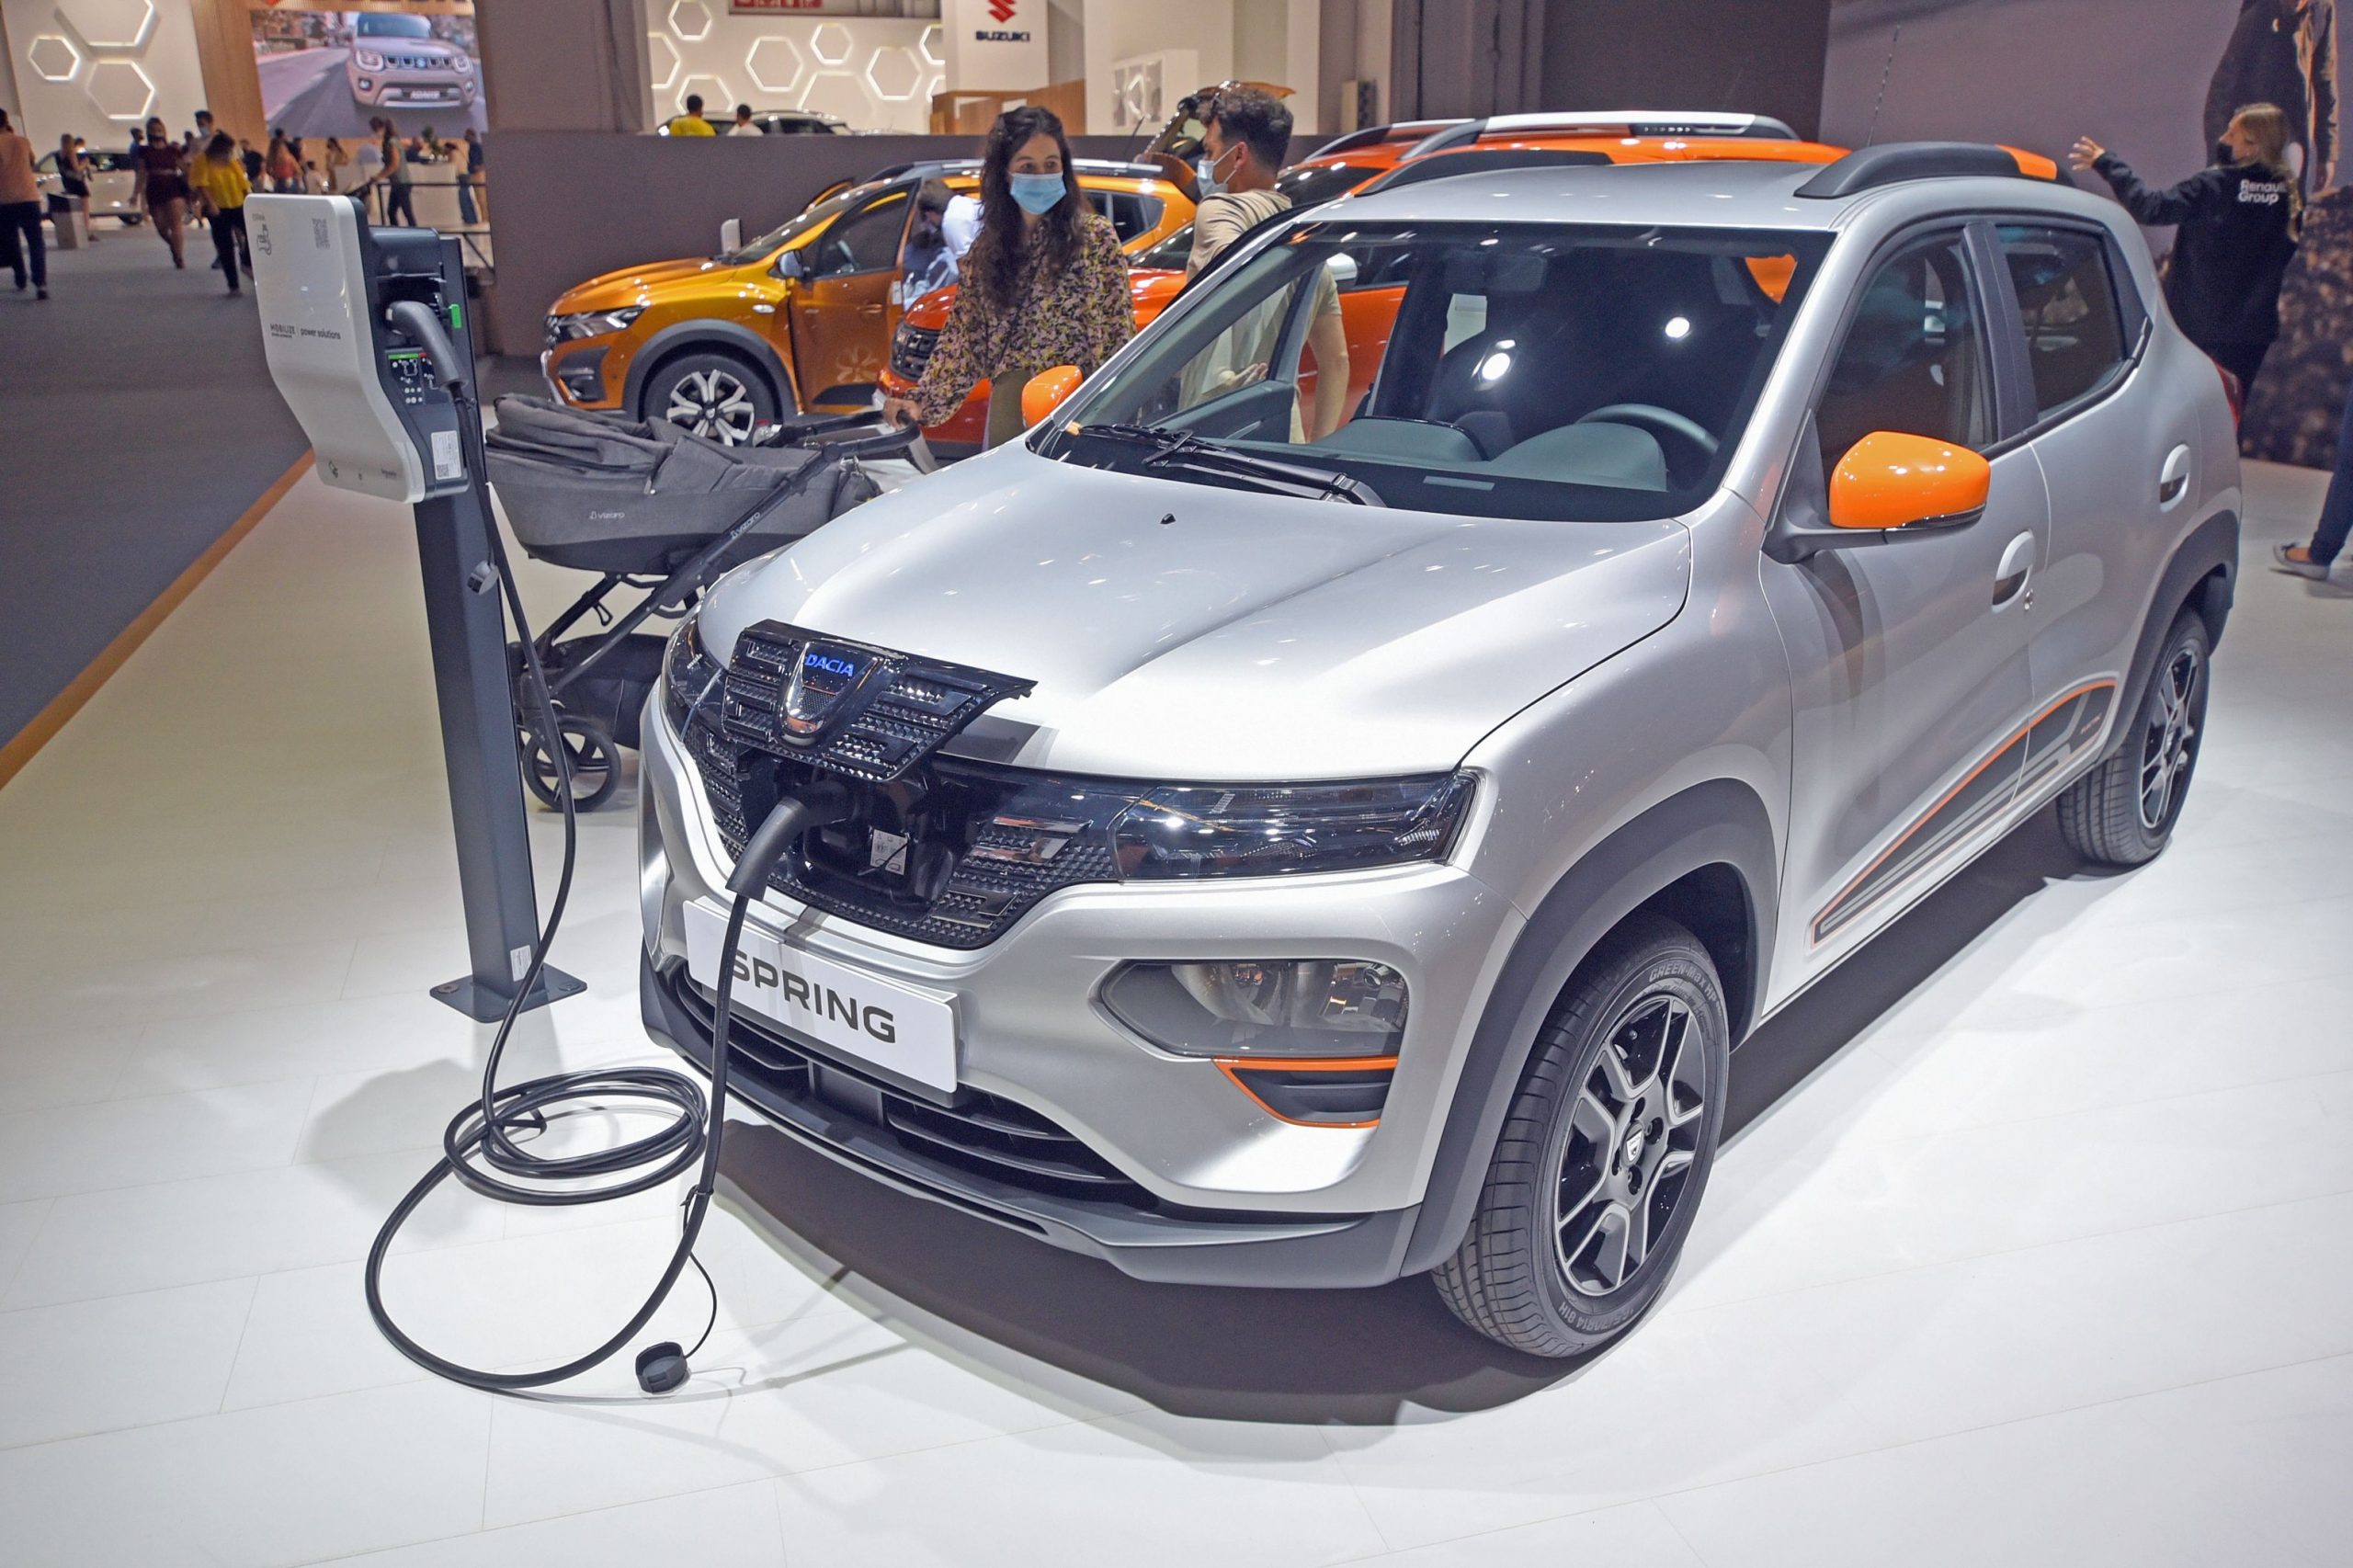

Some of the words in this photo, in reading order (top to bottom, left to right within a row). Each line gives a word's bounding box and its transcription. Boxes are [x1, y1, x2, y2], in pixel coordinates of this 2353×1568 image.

[975, 30, 1030, 42] SUZUKI
[2238, 192, 2279, 206] Group
[300, 327, 316, 337] power
[317, 328, 341, 340] solutions
[804, 653, 855, 677] DACIA
[732, 949, 896, 1044] SPRING
